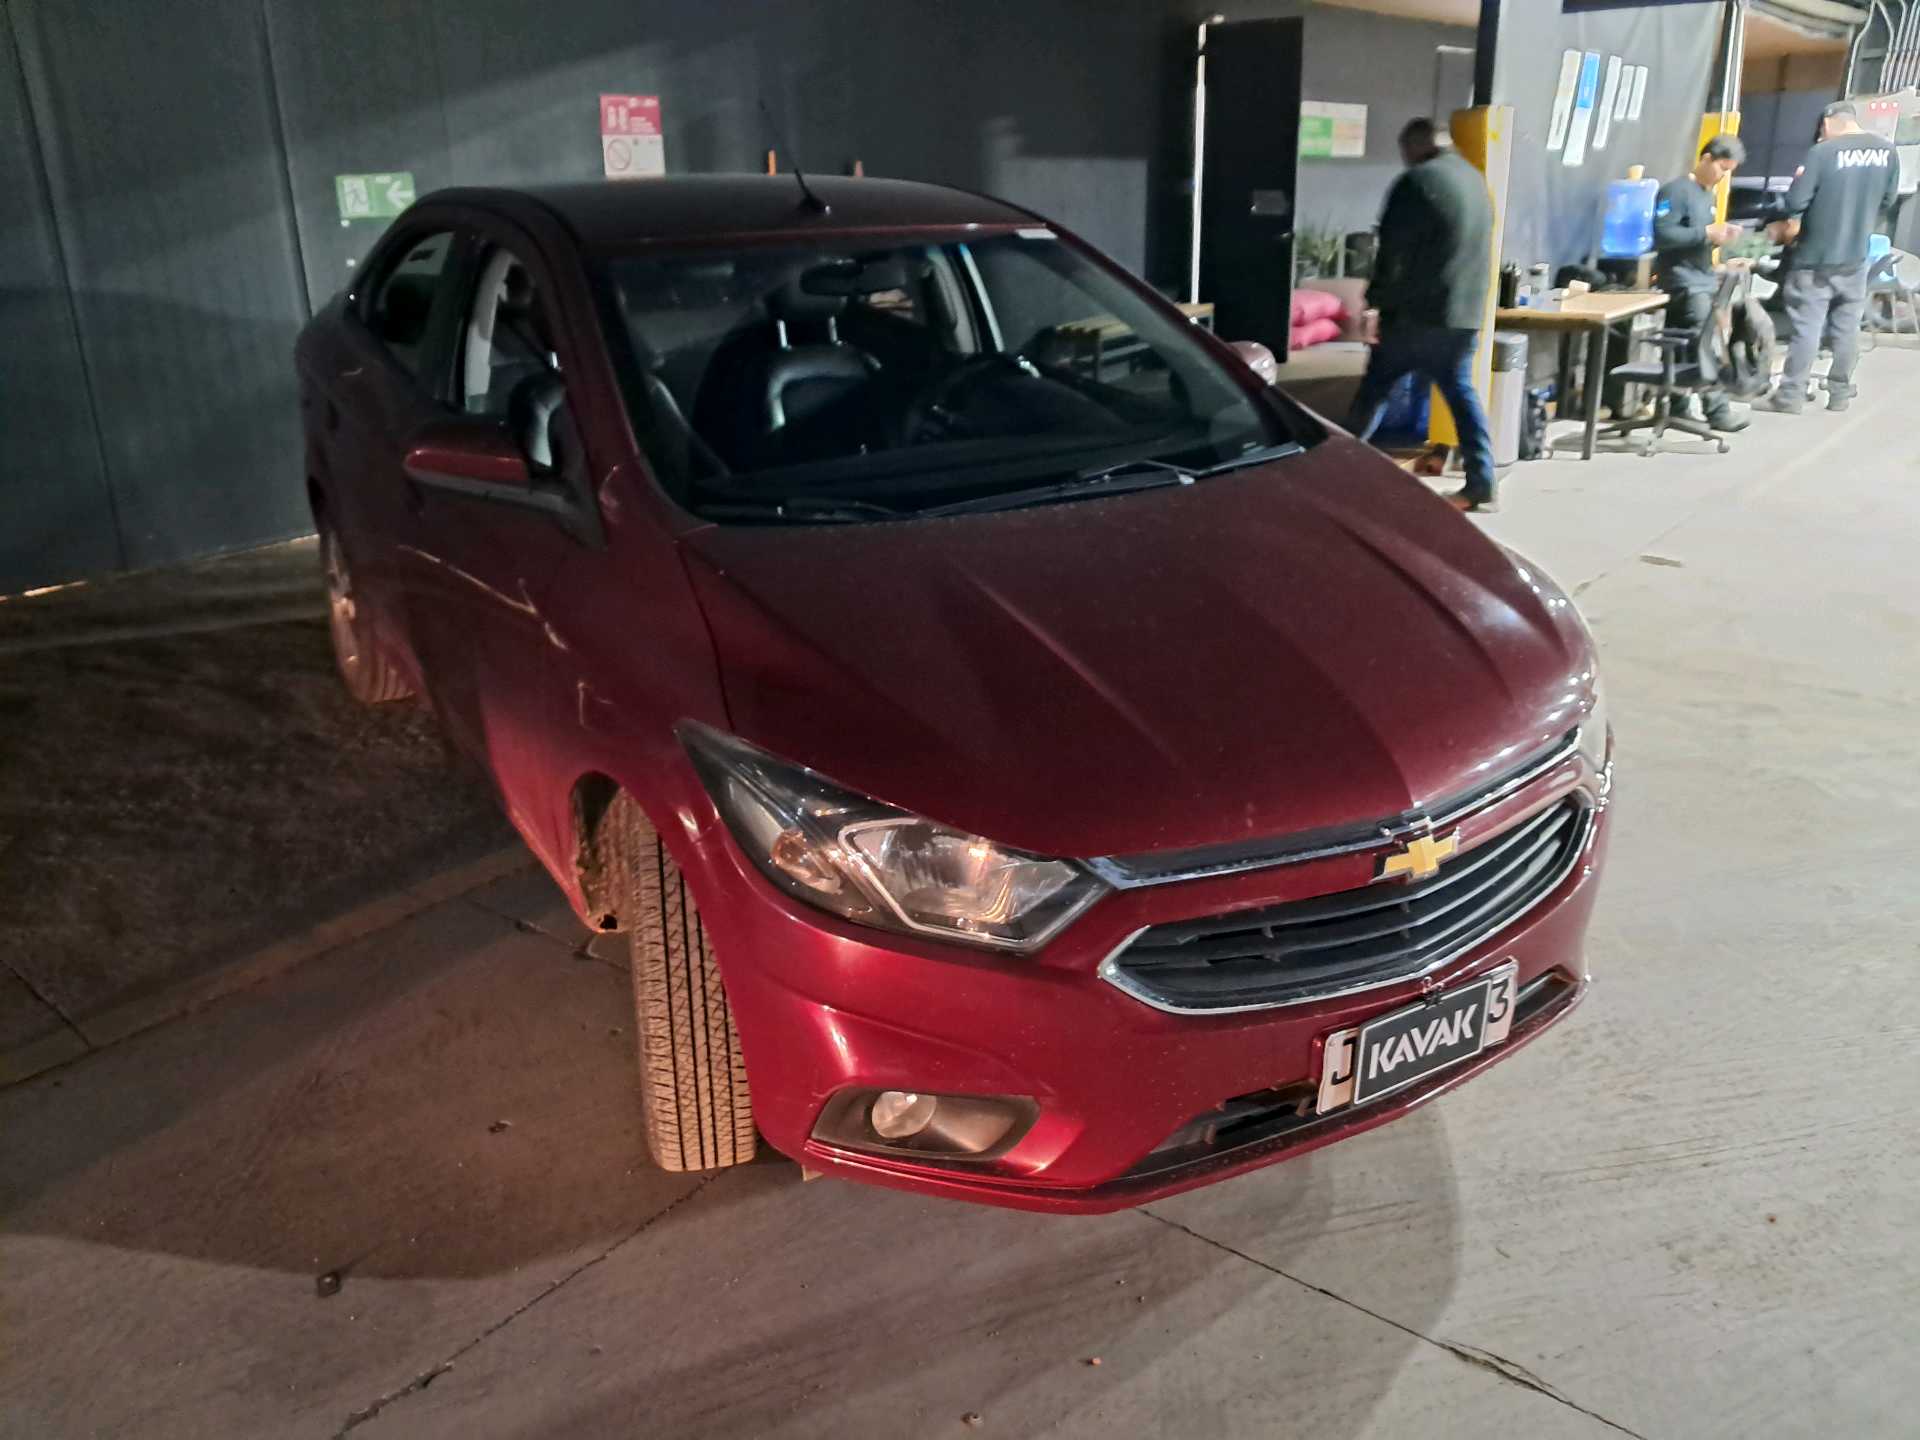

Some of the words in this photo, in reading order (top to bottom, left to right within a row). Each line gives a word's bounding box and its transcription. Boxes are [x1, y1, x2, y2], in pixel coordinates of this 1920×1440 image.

[1837, 148, 1890, 169] KAVAK
[1487, 979, 1510, 1024] 3
[1368, 1003, 1479, 1080] KAVAK
